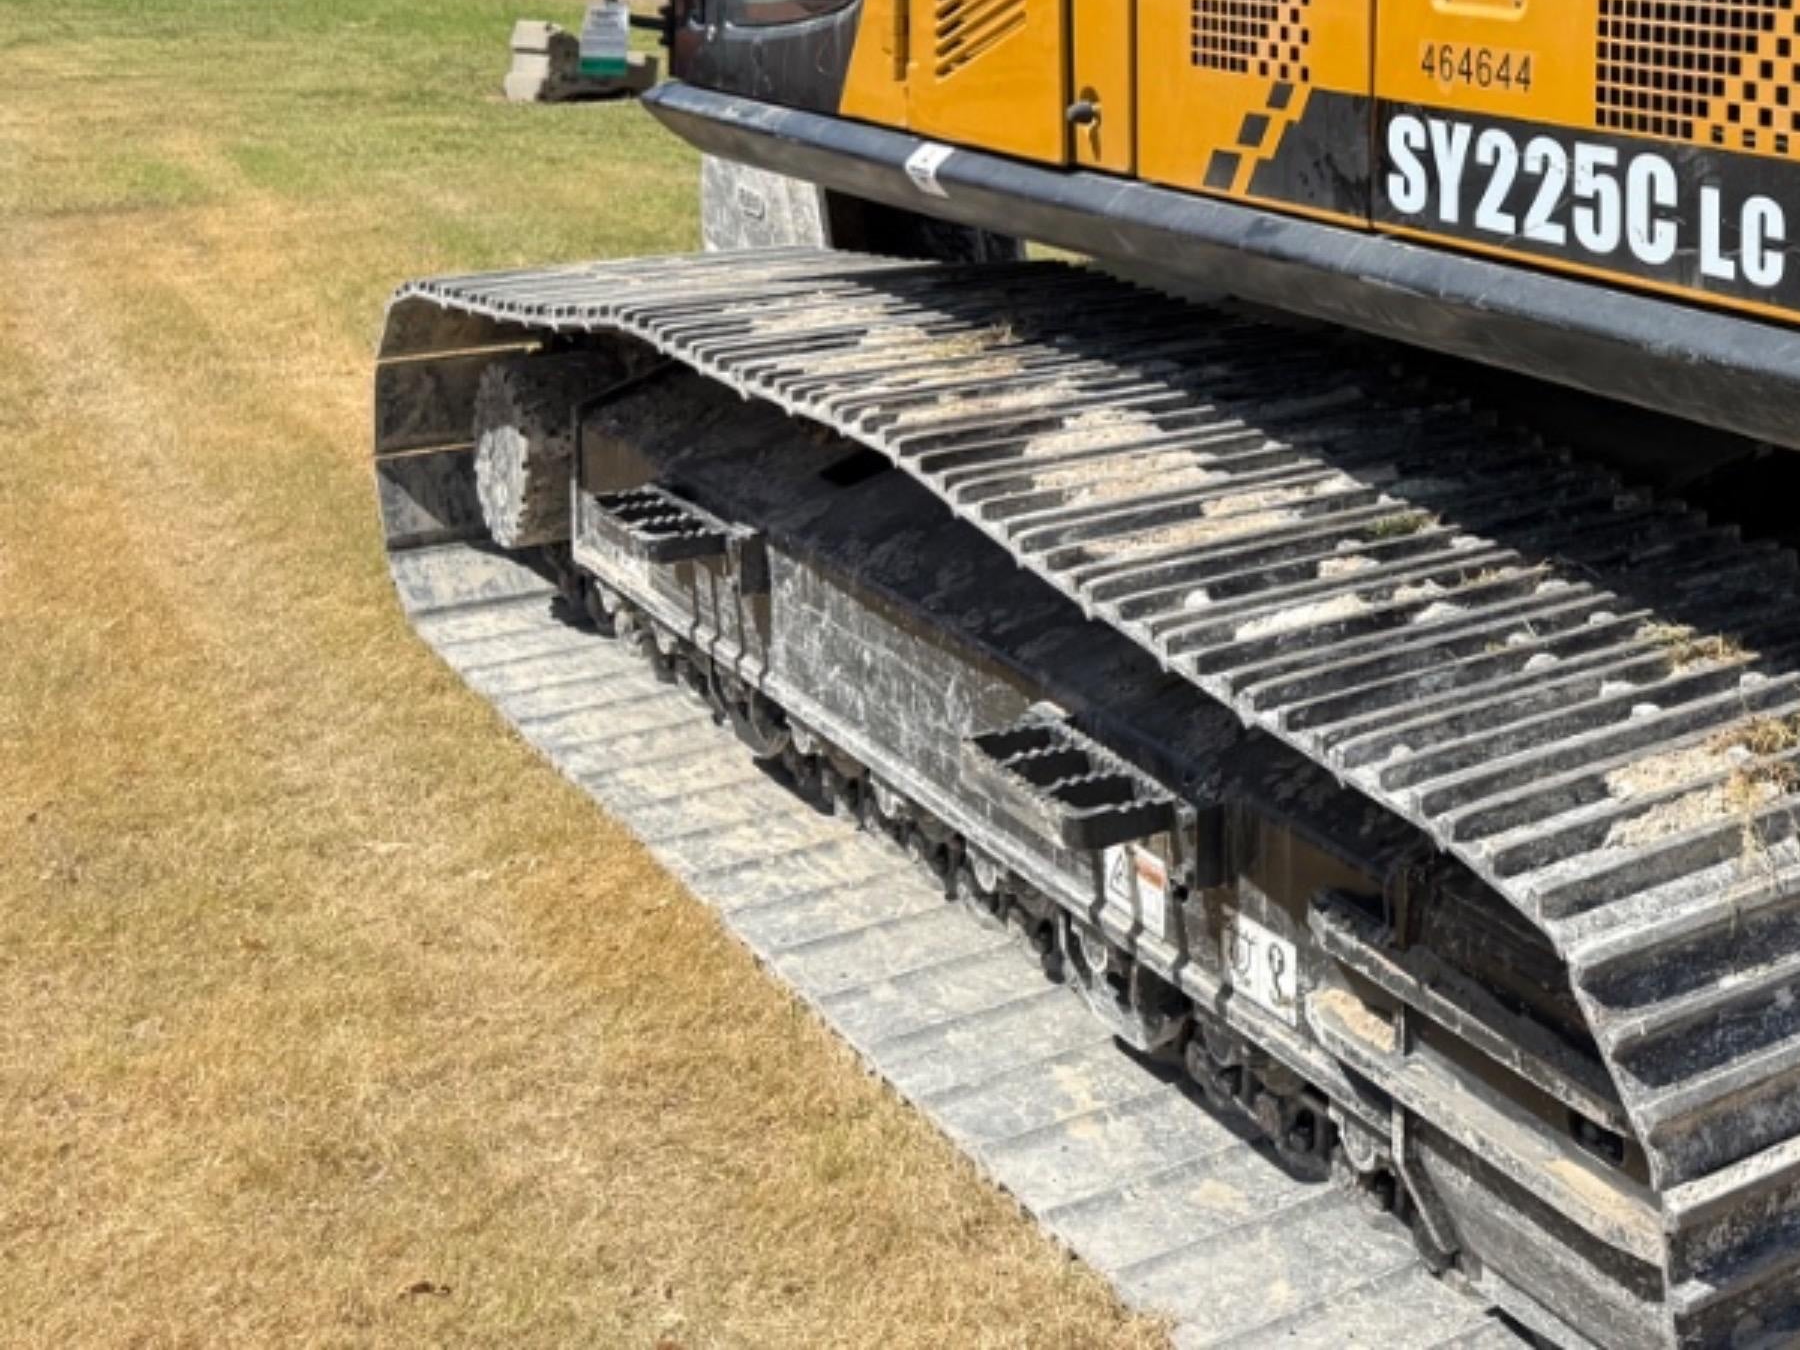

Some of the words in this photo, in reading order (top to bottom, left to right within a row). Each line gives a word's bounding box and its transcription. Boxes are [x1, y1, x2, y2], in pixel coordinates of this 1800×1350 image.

[1421, 43, 1533, 93] 464644
[1387, 113, 1679, 265] SY225C
[1699, 185, 1787, 288] LC
